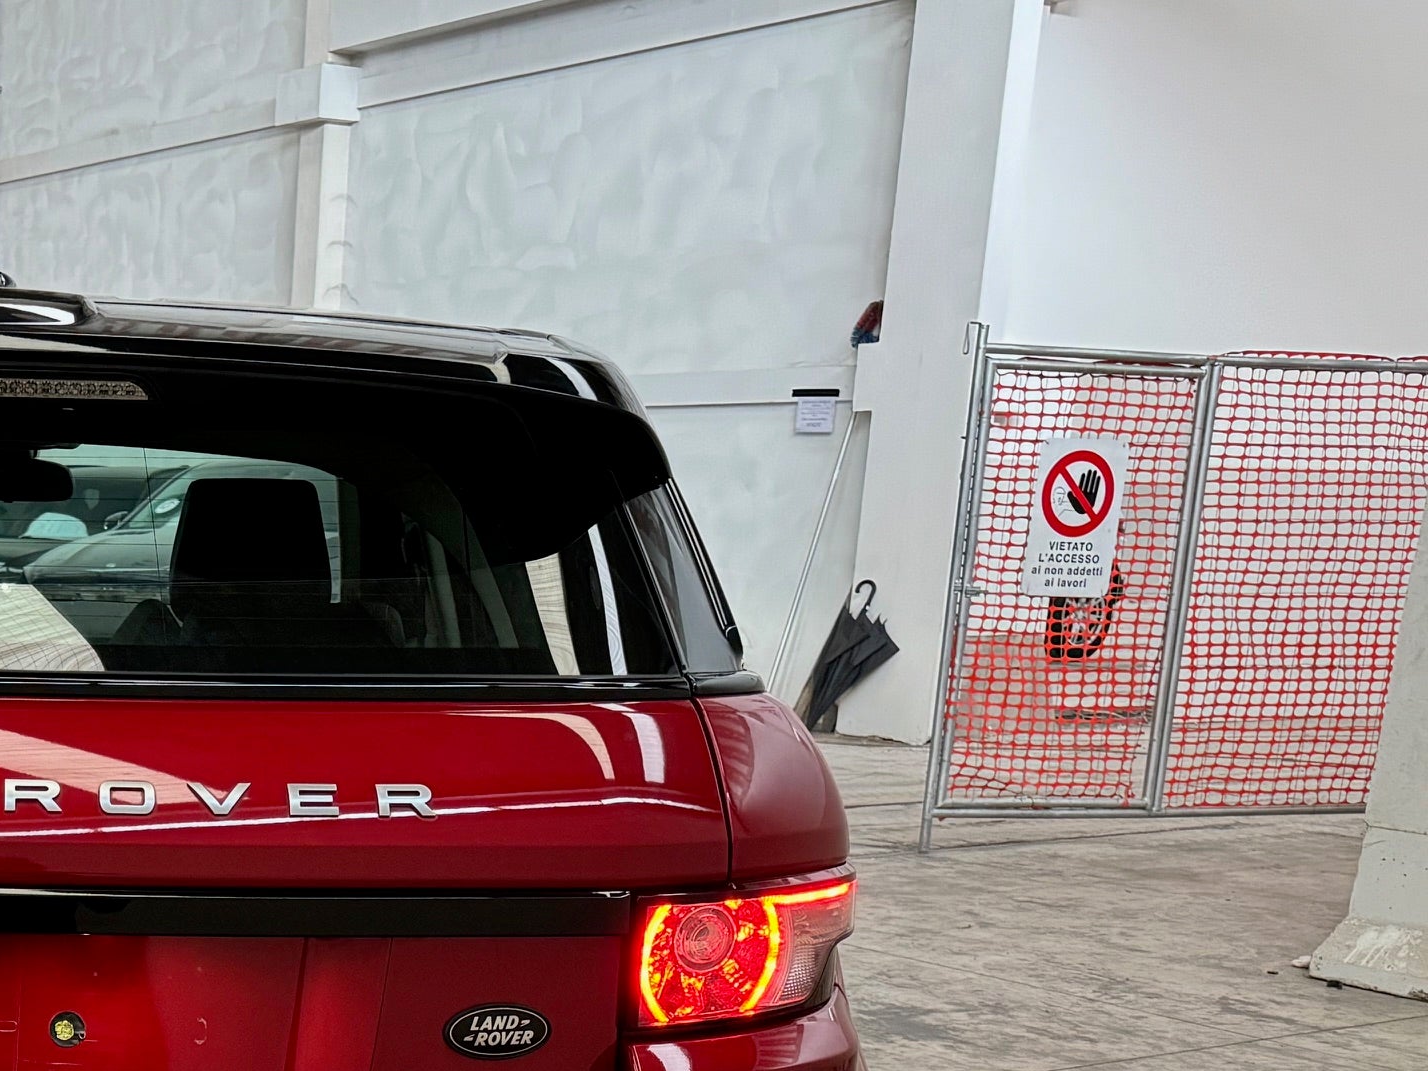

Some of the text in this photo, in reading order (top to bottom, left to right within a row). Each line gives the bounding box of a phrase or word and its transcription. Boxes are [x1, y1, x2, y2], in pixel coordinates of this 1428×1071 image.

[1049, 541, 1093, 552] VIETATO
[1038, 553, 1100, 564] L'ACCESSO
[1031, 566, 1103, 576] ai non addetti
[1044, 577, 1087, 588] ai lavori
[3, 778, 438, 818] ROVER
